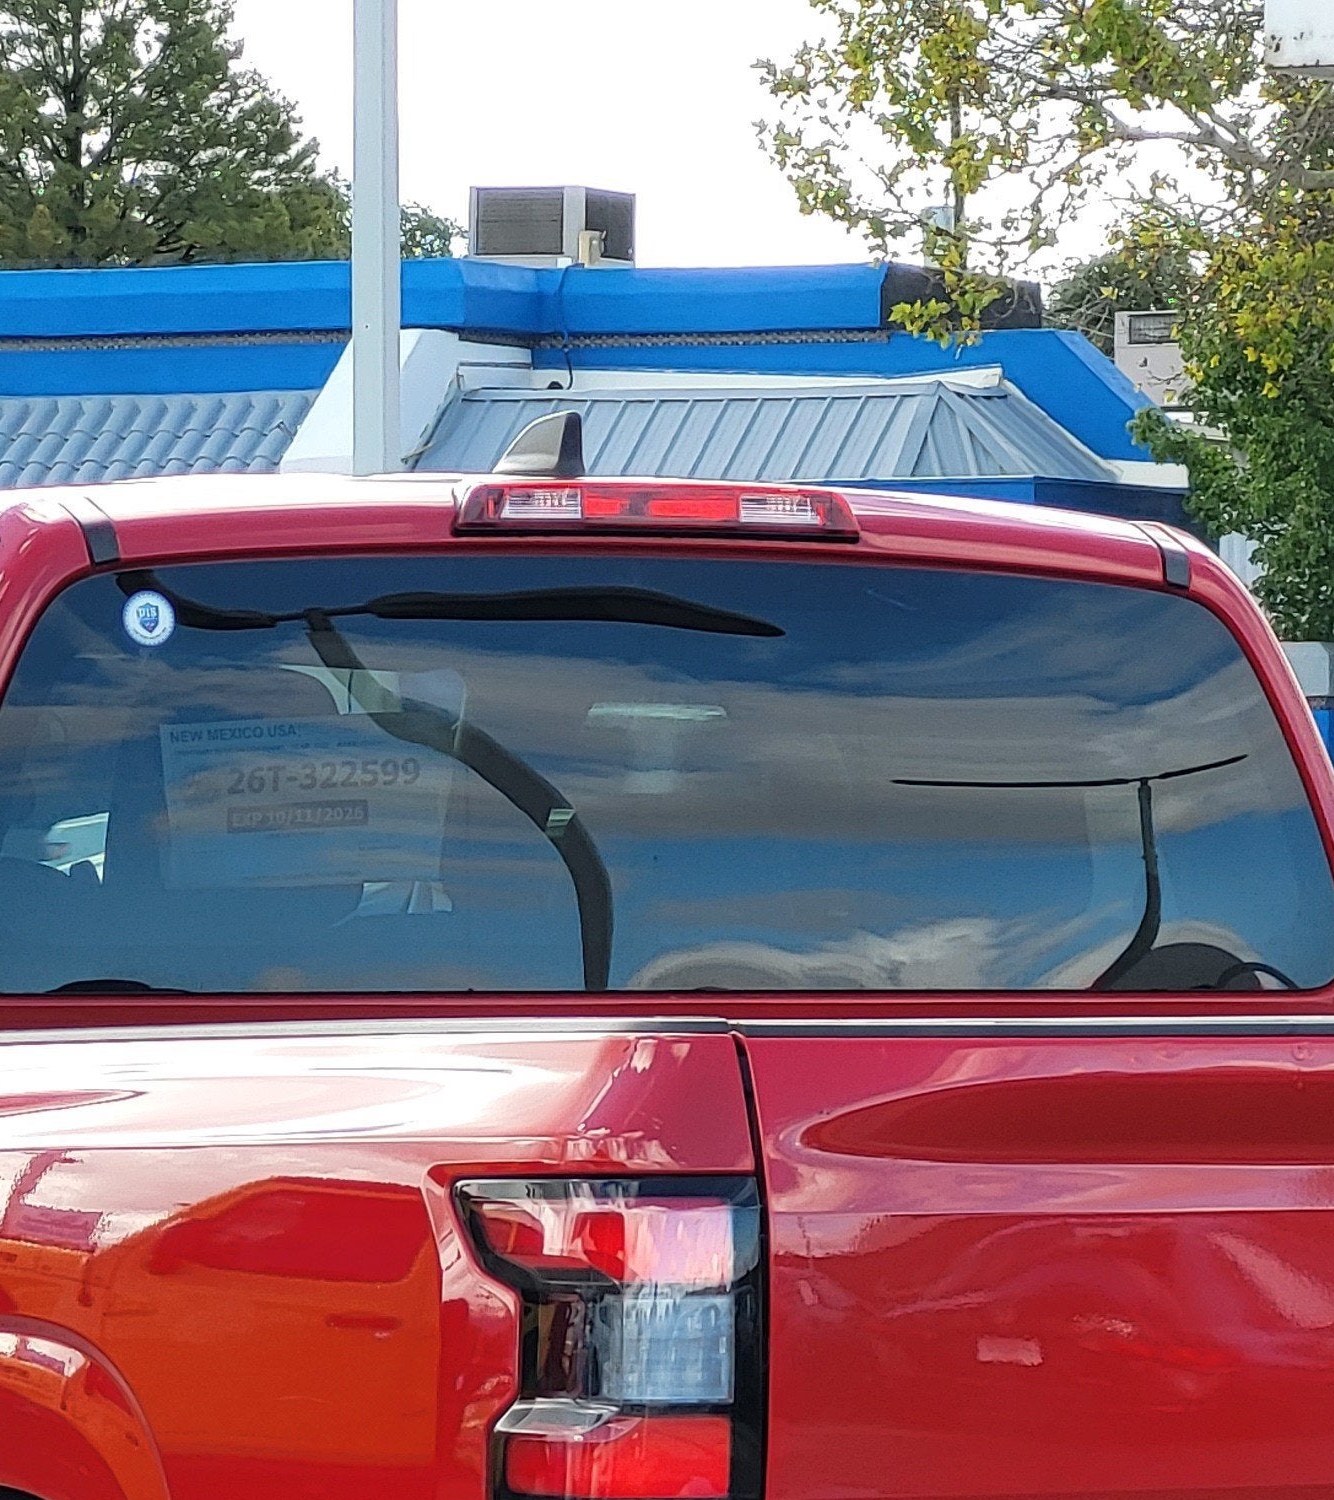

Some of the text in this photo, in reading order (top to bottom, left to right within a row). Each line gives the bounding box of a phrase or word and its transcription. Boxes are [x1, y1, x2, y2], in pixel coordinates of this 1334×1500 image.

[170, 730, 203, 744] NEW
[207, 726, 264, 742] MEXICO
[227, 757, 421, 796] 26T-322599
